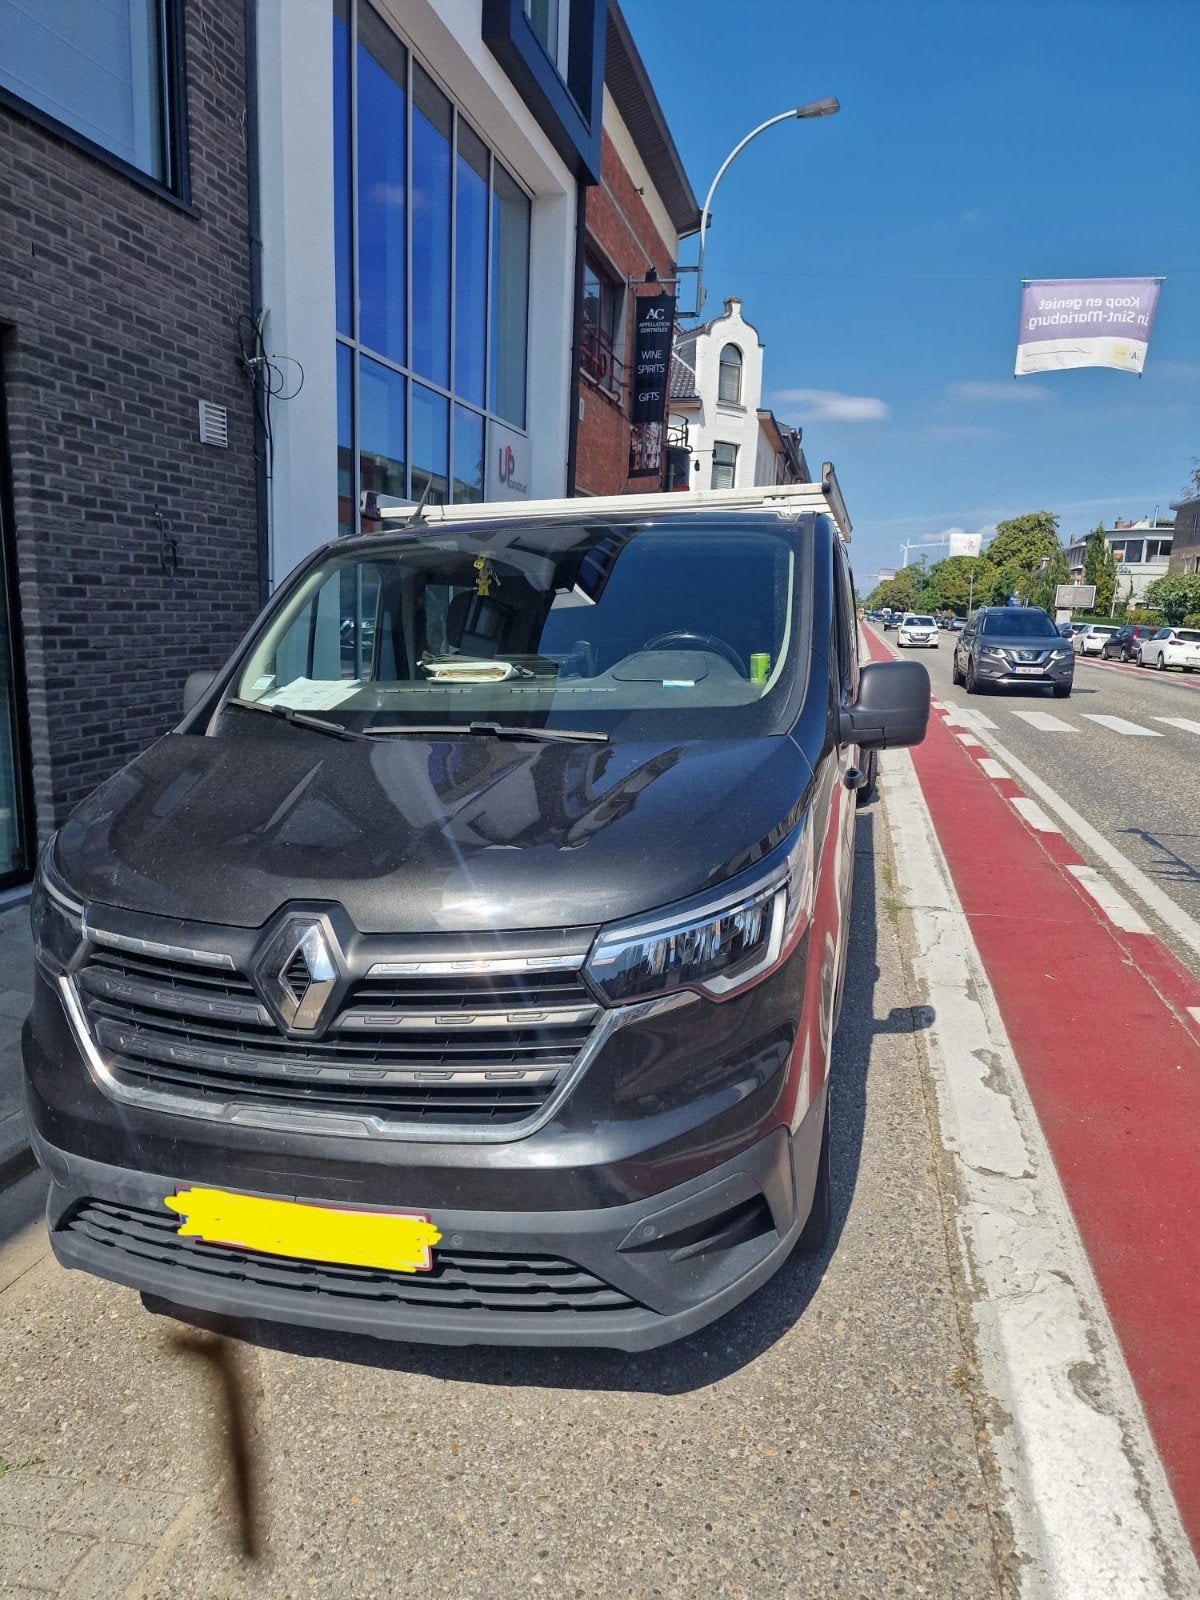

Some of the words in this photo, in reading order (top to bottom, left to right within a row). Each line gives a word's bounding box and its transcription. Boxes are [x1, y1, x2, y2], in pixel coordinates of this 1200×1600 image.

[645, 308, 665, 320] AC
[641, 349, 663, 359] WINE
[637, 363, 665, 374] SPIRITS
[638, 391, 660, 401] GIFTS
